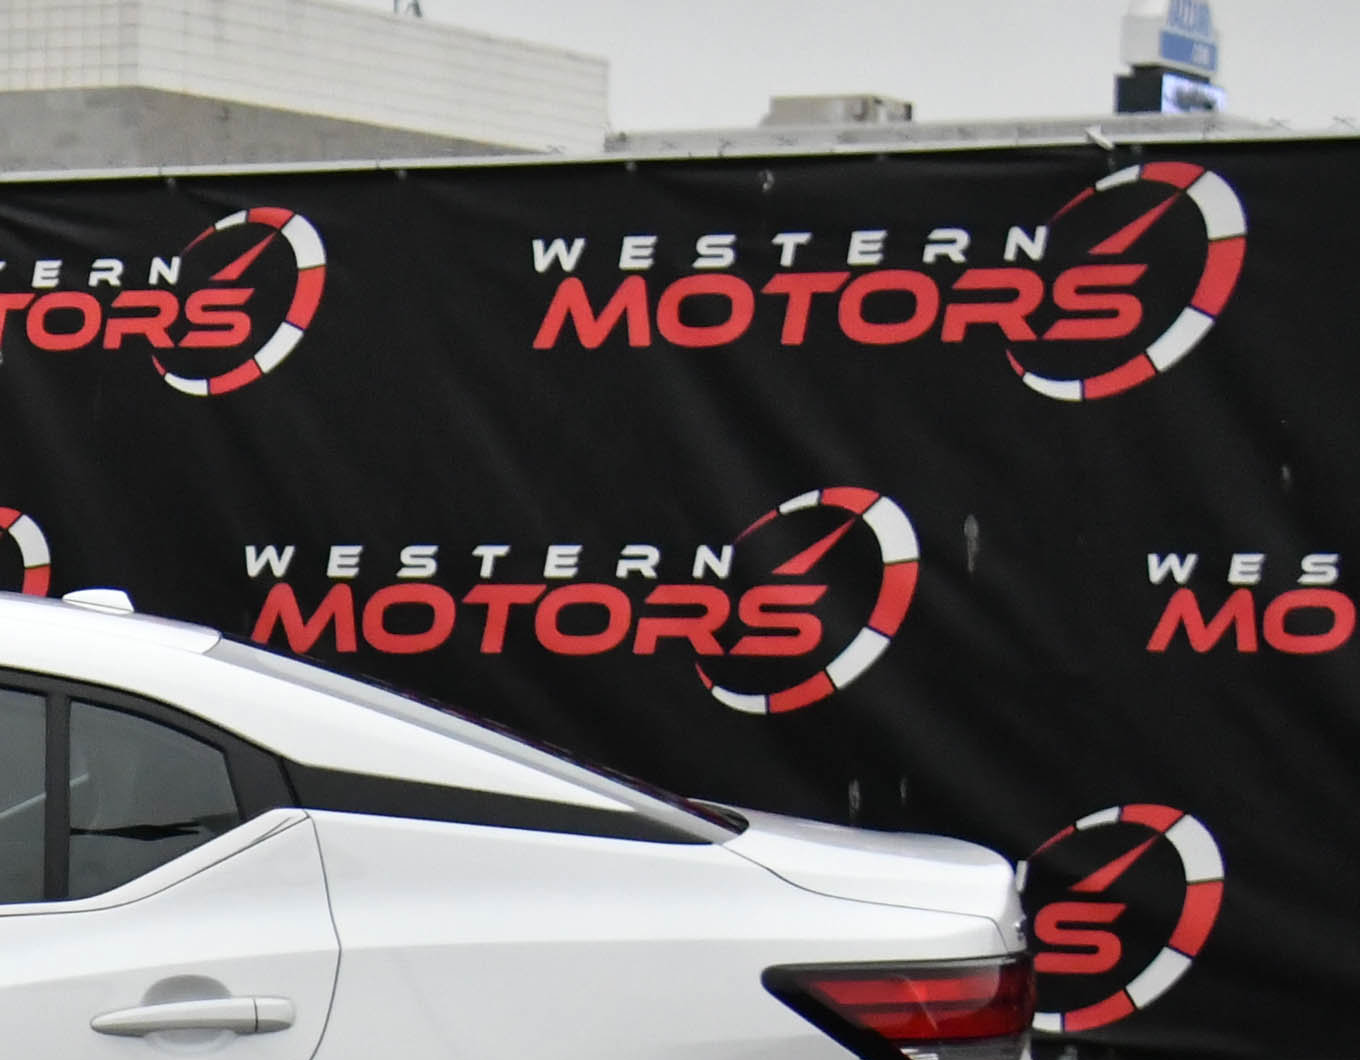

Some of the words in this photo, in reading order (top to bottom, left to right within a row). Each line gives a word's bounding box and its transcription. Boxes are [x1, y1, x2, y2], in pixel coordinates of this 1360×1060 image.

[532, 225, 1049, 273] WESTERN
[532, 264, 1148, 349] MOTORS
[244, 544, 735, 579] WESTERN
[1146, 553, 1341, 585] WES
[250, 583, 829, 656] MOTORS
[1146, 587, 1357, 655] MO
